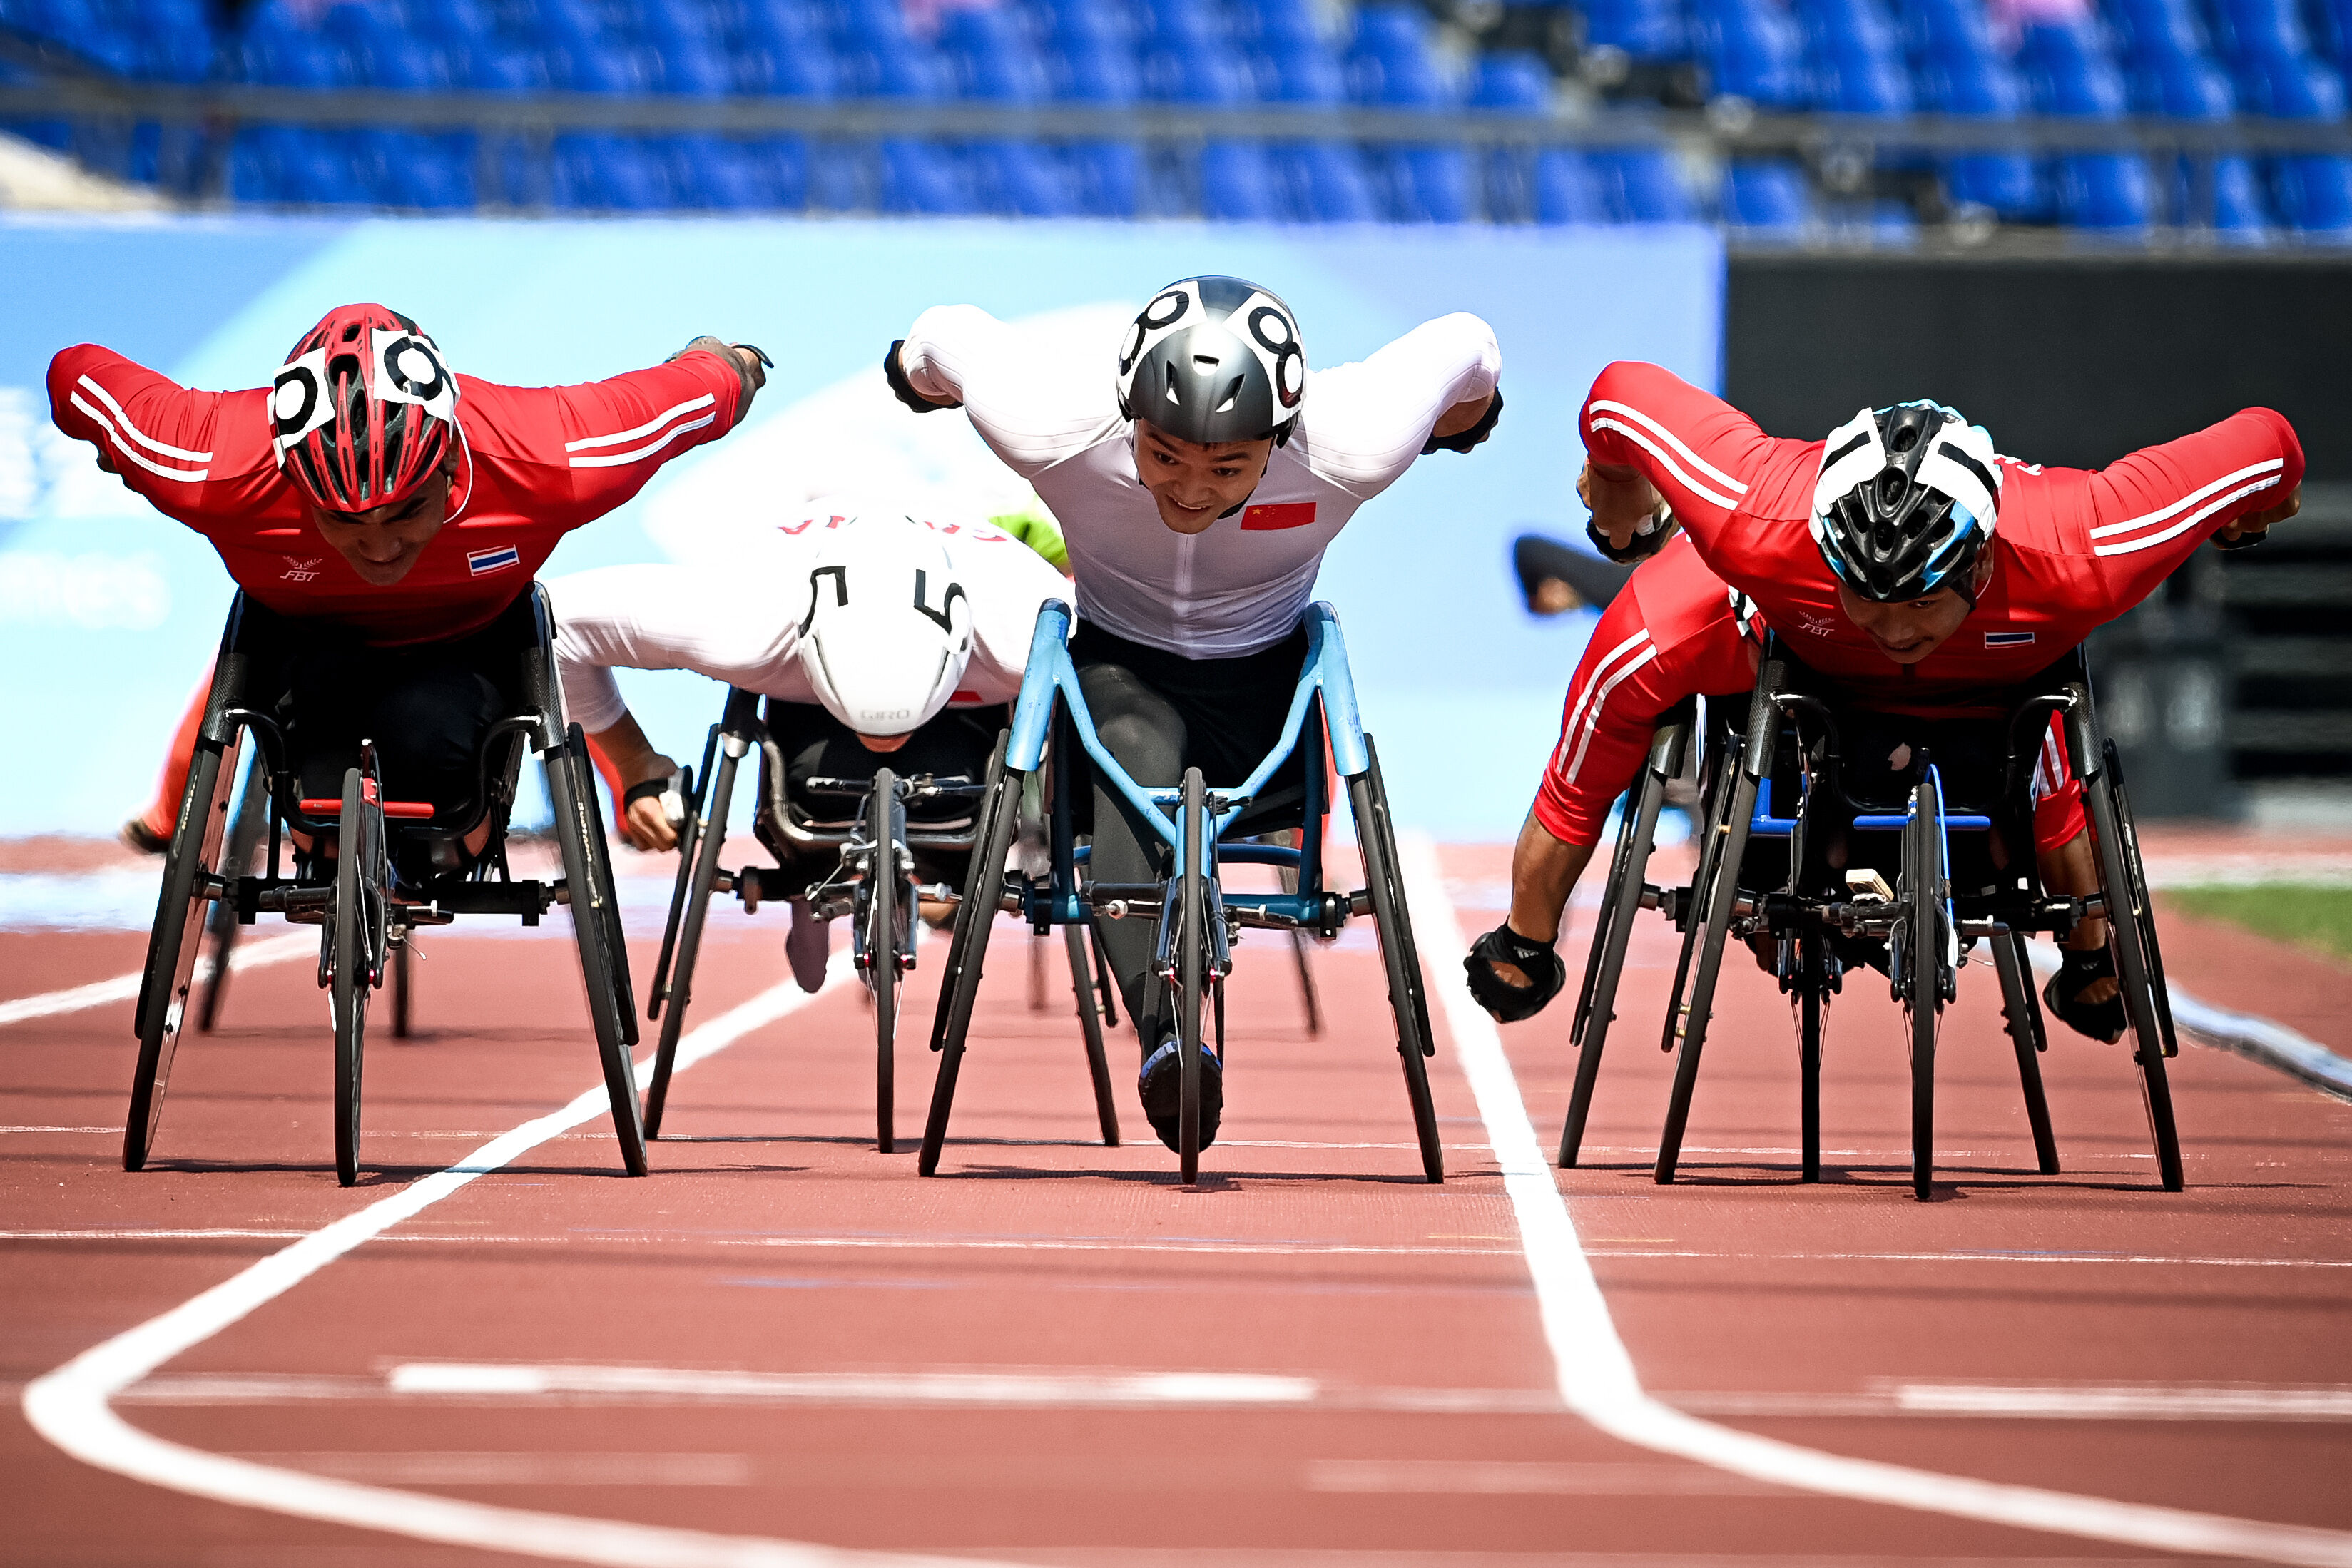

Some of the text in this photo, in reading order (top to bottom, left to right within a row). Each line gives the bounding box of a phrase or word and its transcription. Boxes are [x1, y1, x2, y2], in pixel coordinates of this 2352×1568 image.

[1120, 290, 1189, 376] 8
[1248, 306, 1303, 408] 8
[280, 570, 320, 582] FBT
[1798, 623, 1835, 637] FBT
[860, 709, 910, 721] GIRO
